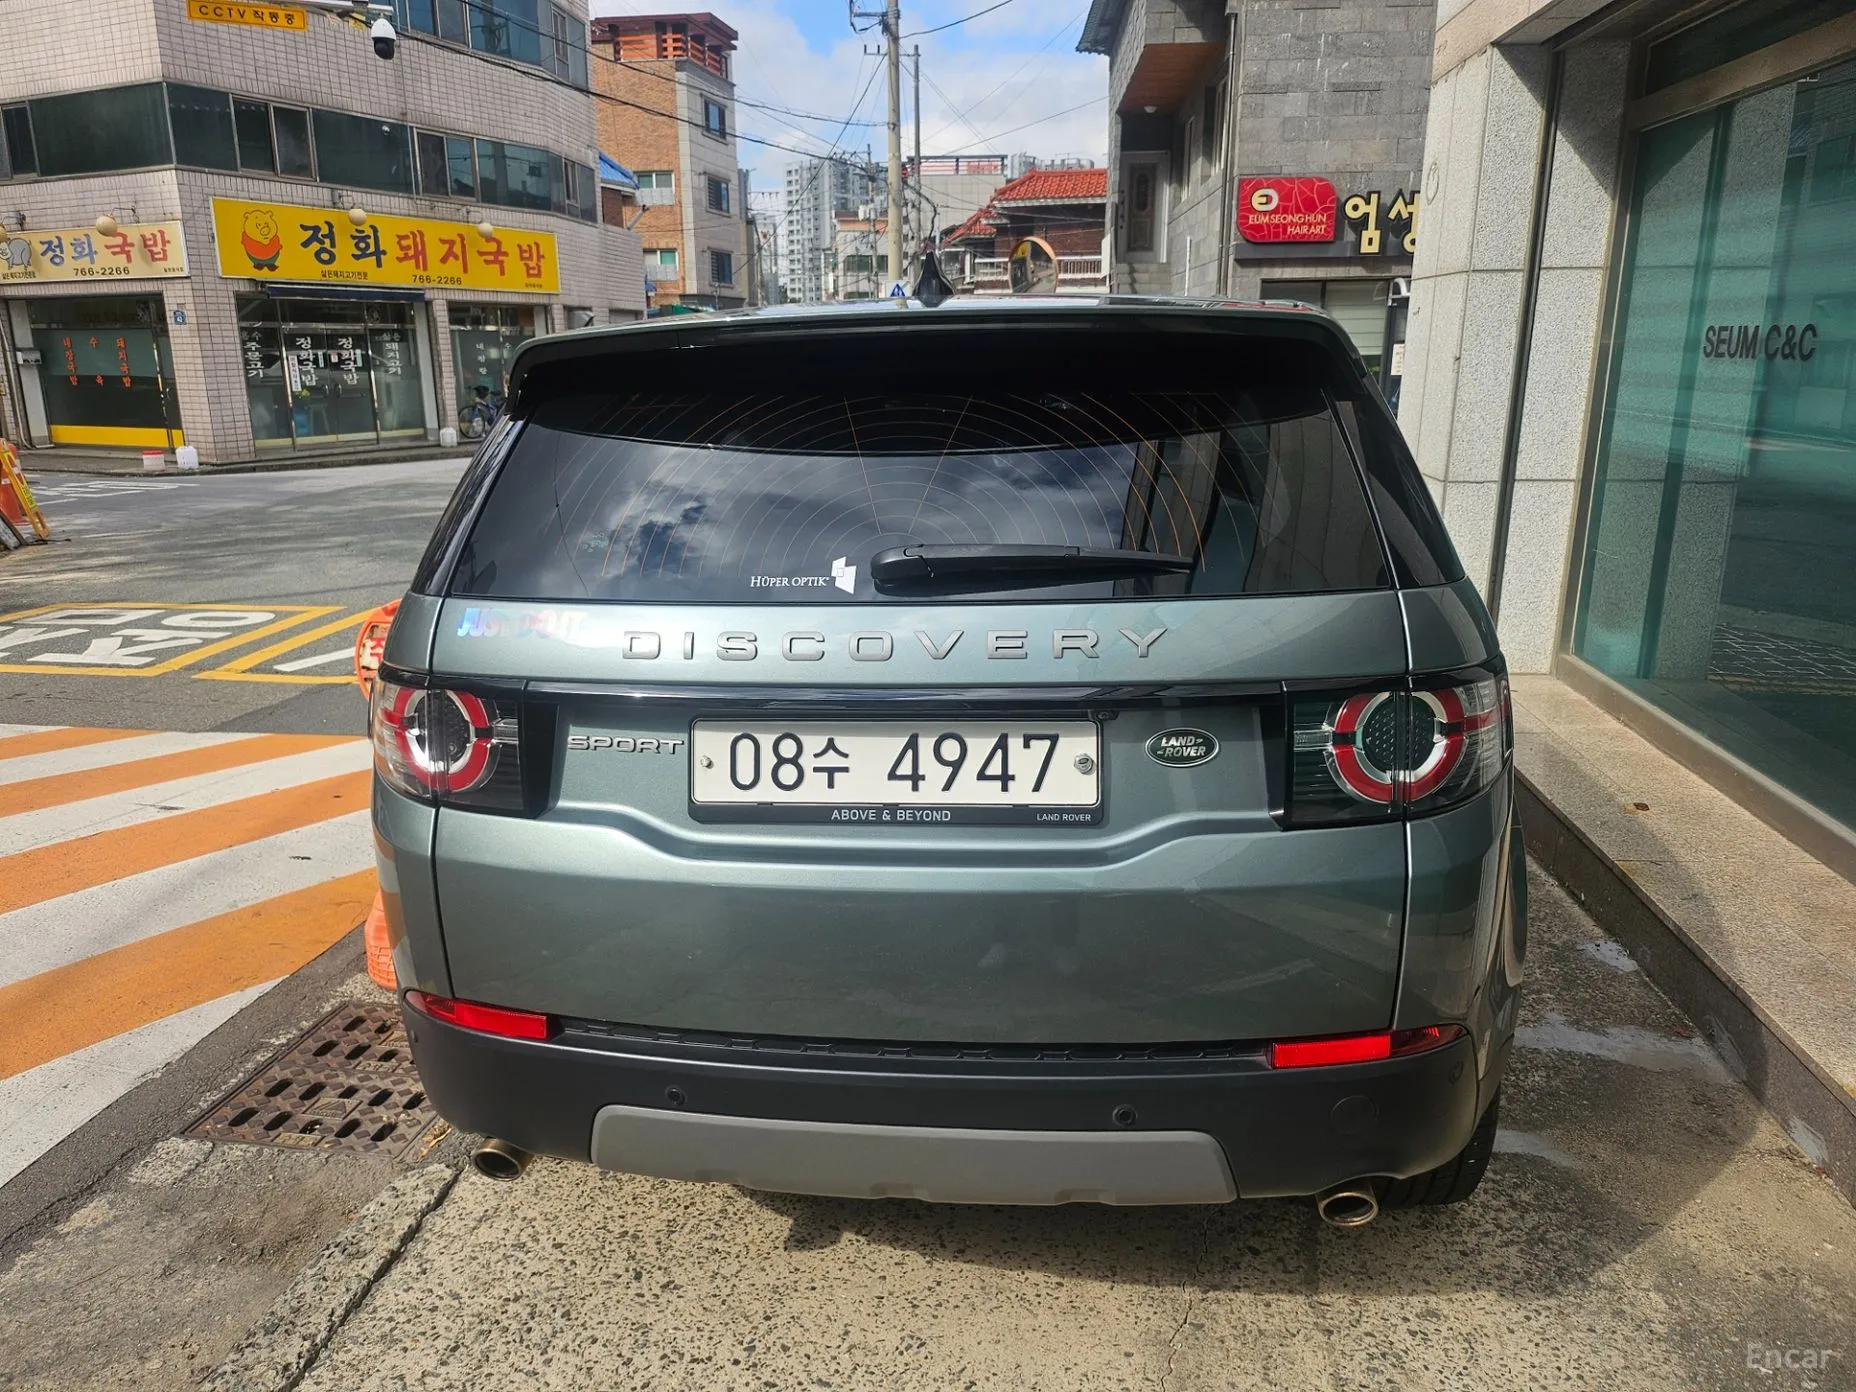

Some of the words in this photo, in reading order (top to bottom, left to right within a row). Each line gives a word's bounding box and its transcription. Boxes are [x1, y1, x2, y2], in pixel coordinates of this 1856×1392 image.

[199, 5, 247, 18] CCTV
[1287, 225, 1308, 235] HAIR
[1308, 224, 1327, 234] ART
[73, 266, 130, 277] 766-2266
[411, 274, 463, 286] 766-2266
[1703, 325, 1760, 360] SEUM
[1764, 323, 1818, 361] C&C
[295, 336, 318, 386] 정화국밥
[338, 336, 359, 385] 정화국밥
[622, 627, 1169, 662] DISCOVERY
[567, 735, 684, 755] SPORT
[1161, 736, 1195, 746] LAND
[1165, 746, 1206, 757] ROVER
[730, 732, 850, 791] 08수
[887, 732, 1060, 792] 4947
[831, 809, 876, 821] ABOVE
[882, 810, 891, 821] &
[897, 810, 950, 821] BEYOND
[1036, 813, 1060, 821] LAND
[1062, 813, 1091, 821] ROVER
